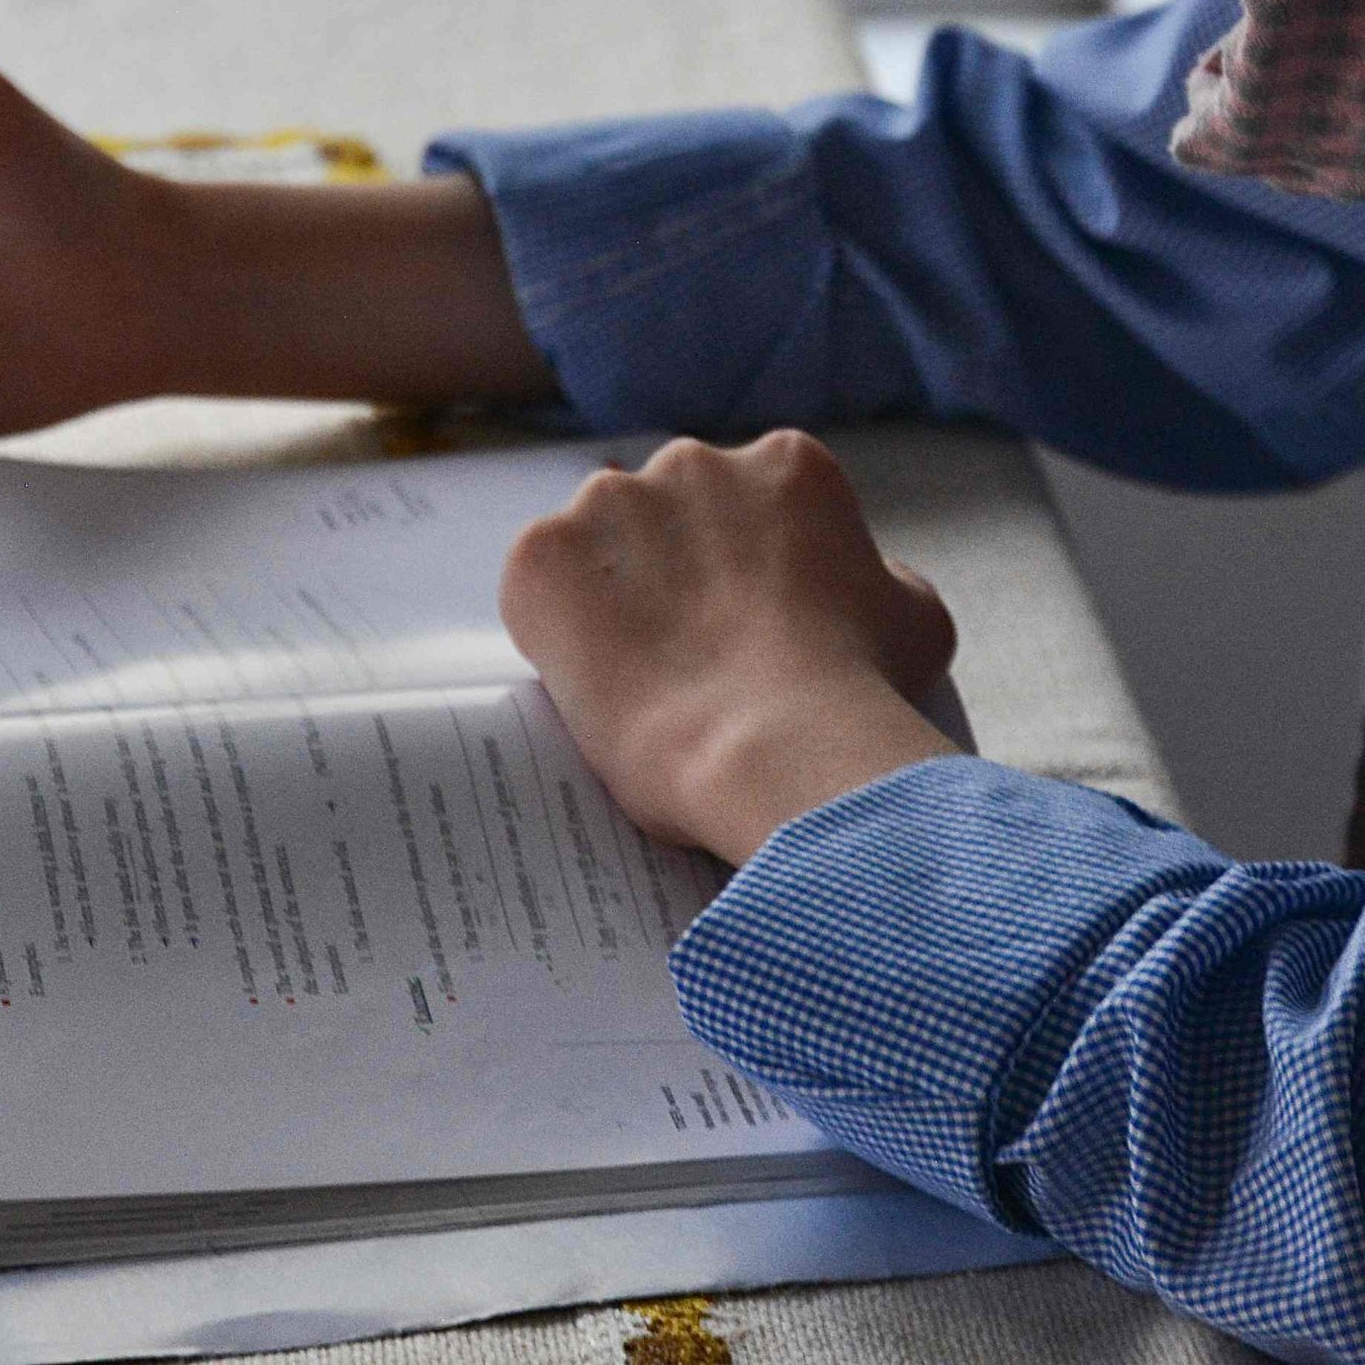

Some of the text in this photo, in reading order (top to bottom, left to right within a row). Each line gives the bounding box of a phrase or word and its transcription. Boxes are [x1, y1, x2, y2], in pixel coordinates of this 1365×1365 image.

[227, 763, 253, 802] copular
[383, 757, 410, 805] following
[157, 806, 183, 846] copular
[237, 814, 263, 858] follows
[60, 834, 89, 882] adjective
[103, 831, 129, 869] awfully
[134, 834, 161, 882] adjective
[404, 842, 429, 882] phrases
[40, 864, 65, 906] wearing
[253, 886, 280, 925] phrase
[412, 884, 439, 930] adjective
[125, 929, 144, 949] The
[289, 935, 317, 974] subject
[231, 945, 258, 984] copular
